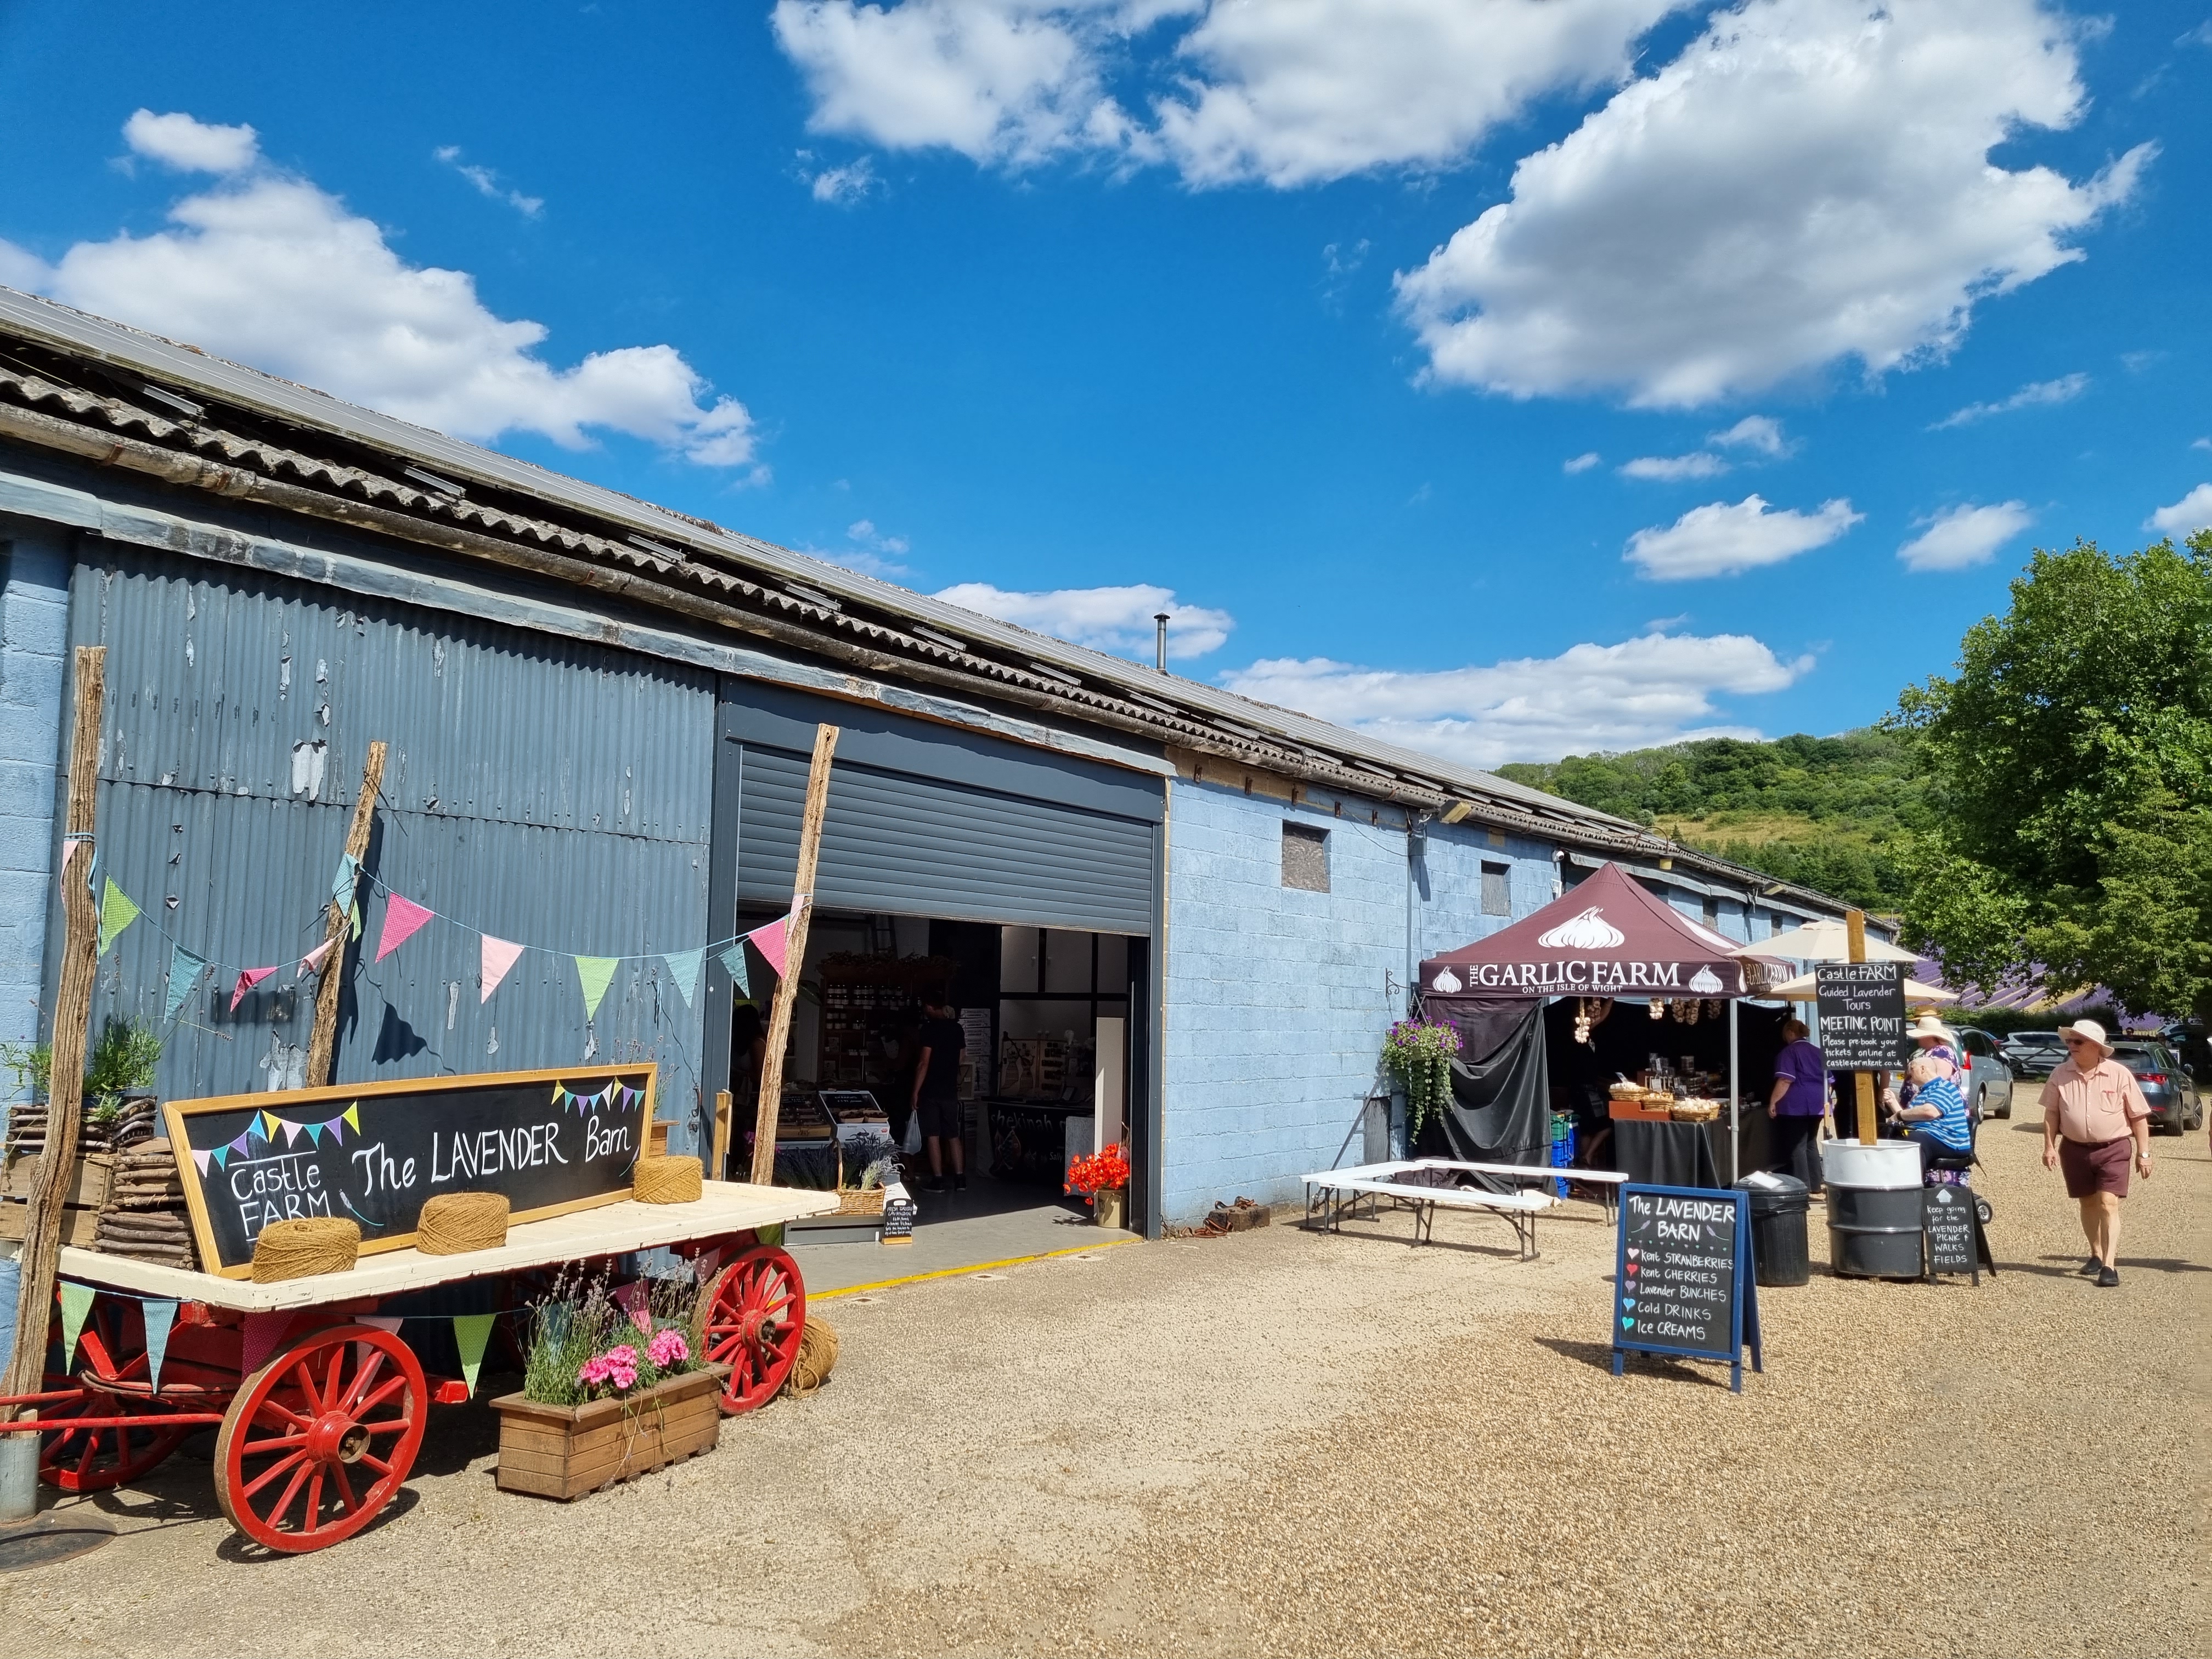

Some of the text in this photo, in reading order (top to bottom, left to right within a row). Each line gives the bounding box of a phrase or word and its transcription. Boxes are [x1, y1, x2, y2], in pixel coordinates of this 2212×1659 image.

[1470, 965, 1479, 988] THE
[1479, 961, 1680, 986] GARLIC FARM
[1818, 966, 1897, 980] Castle FARM
[1819, 985, 1895, 997] Guided Lavender
[1842, 998, 1871, 1011] Tours
[1820, 1016, 1901, 1032] MEETING POINT
[1822, 1035, 1898, 1048] Please pre-book your
[1825, 1048, 1851, 1057] tickets
[1858, 1048, 1883, 1057] online
[352, 1115, 631, 1196] The LAVENDER Barn
[1049, 1152, 1063, 1164] Sally
[231, 1158, 320, 1200] Castle
[240, 1190, 331, 1236] FARM
[1629, 1195, 1735, 1223] The LAVENDER
[1932, 1215, 1943, 1224] for
[1658, 1221, 1700, 1242] BARN
[1928, 1224, 1970, 1233] LAVENDER
[1935, 1243, 1964, 1251] WALKS
[1663, 1252, 1734, 1270] STRAWBERRIES
[1934, 1255, 1967, 1264] FIELDS
[1664, 1268, 1717, 1284] CHERRIES
[1640, 1283, 1726, 1302] Lavender BUNCHES
[1638, 1301, 1711, 1320] Cold DRINKS
[1638, 1320, 1705, 1340] Ice CREAMS
